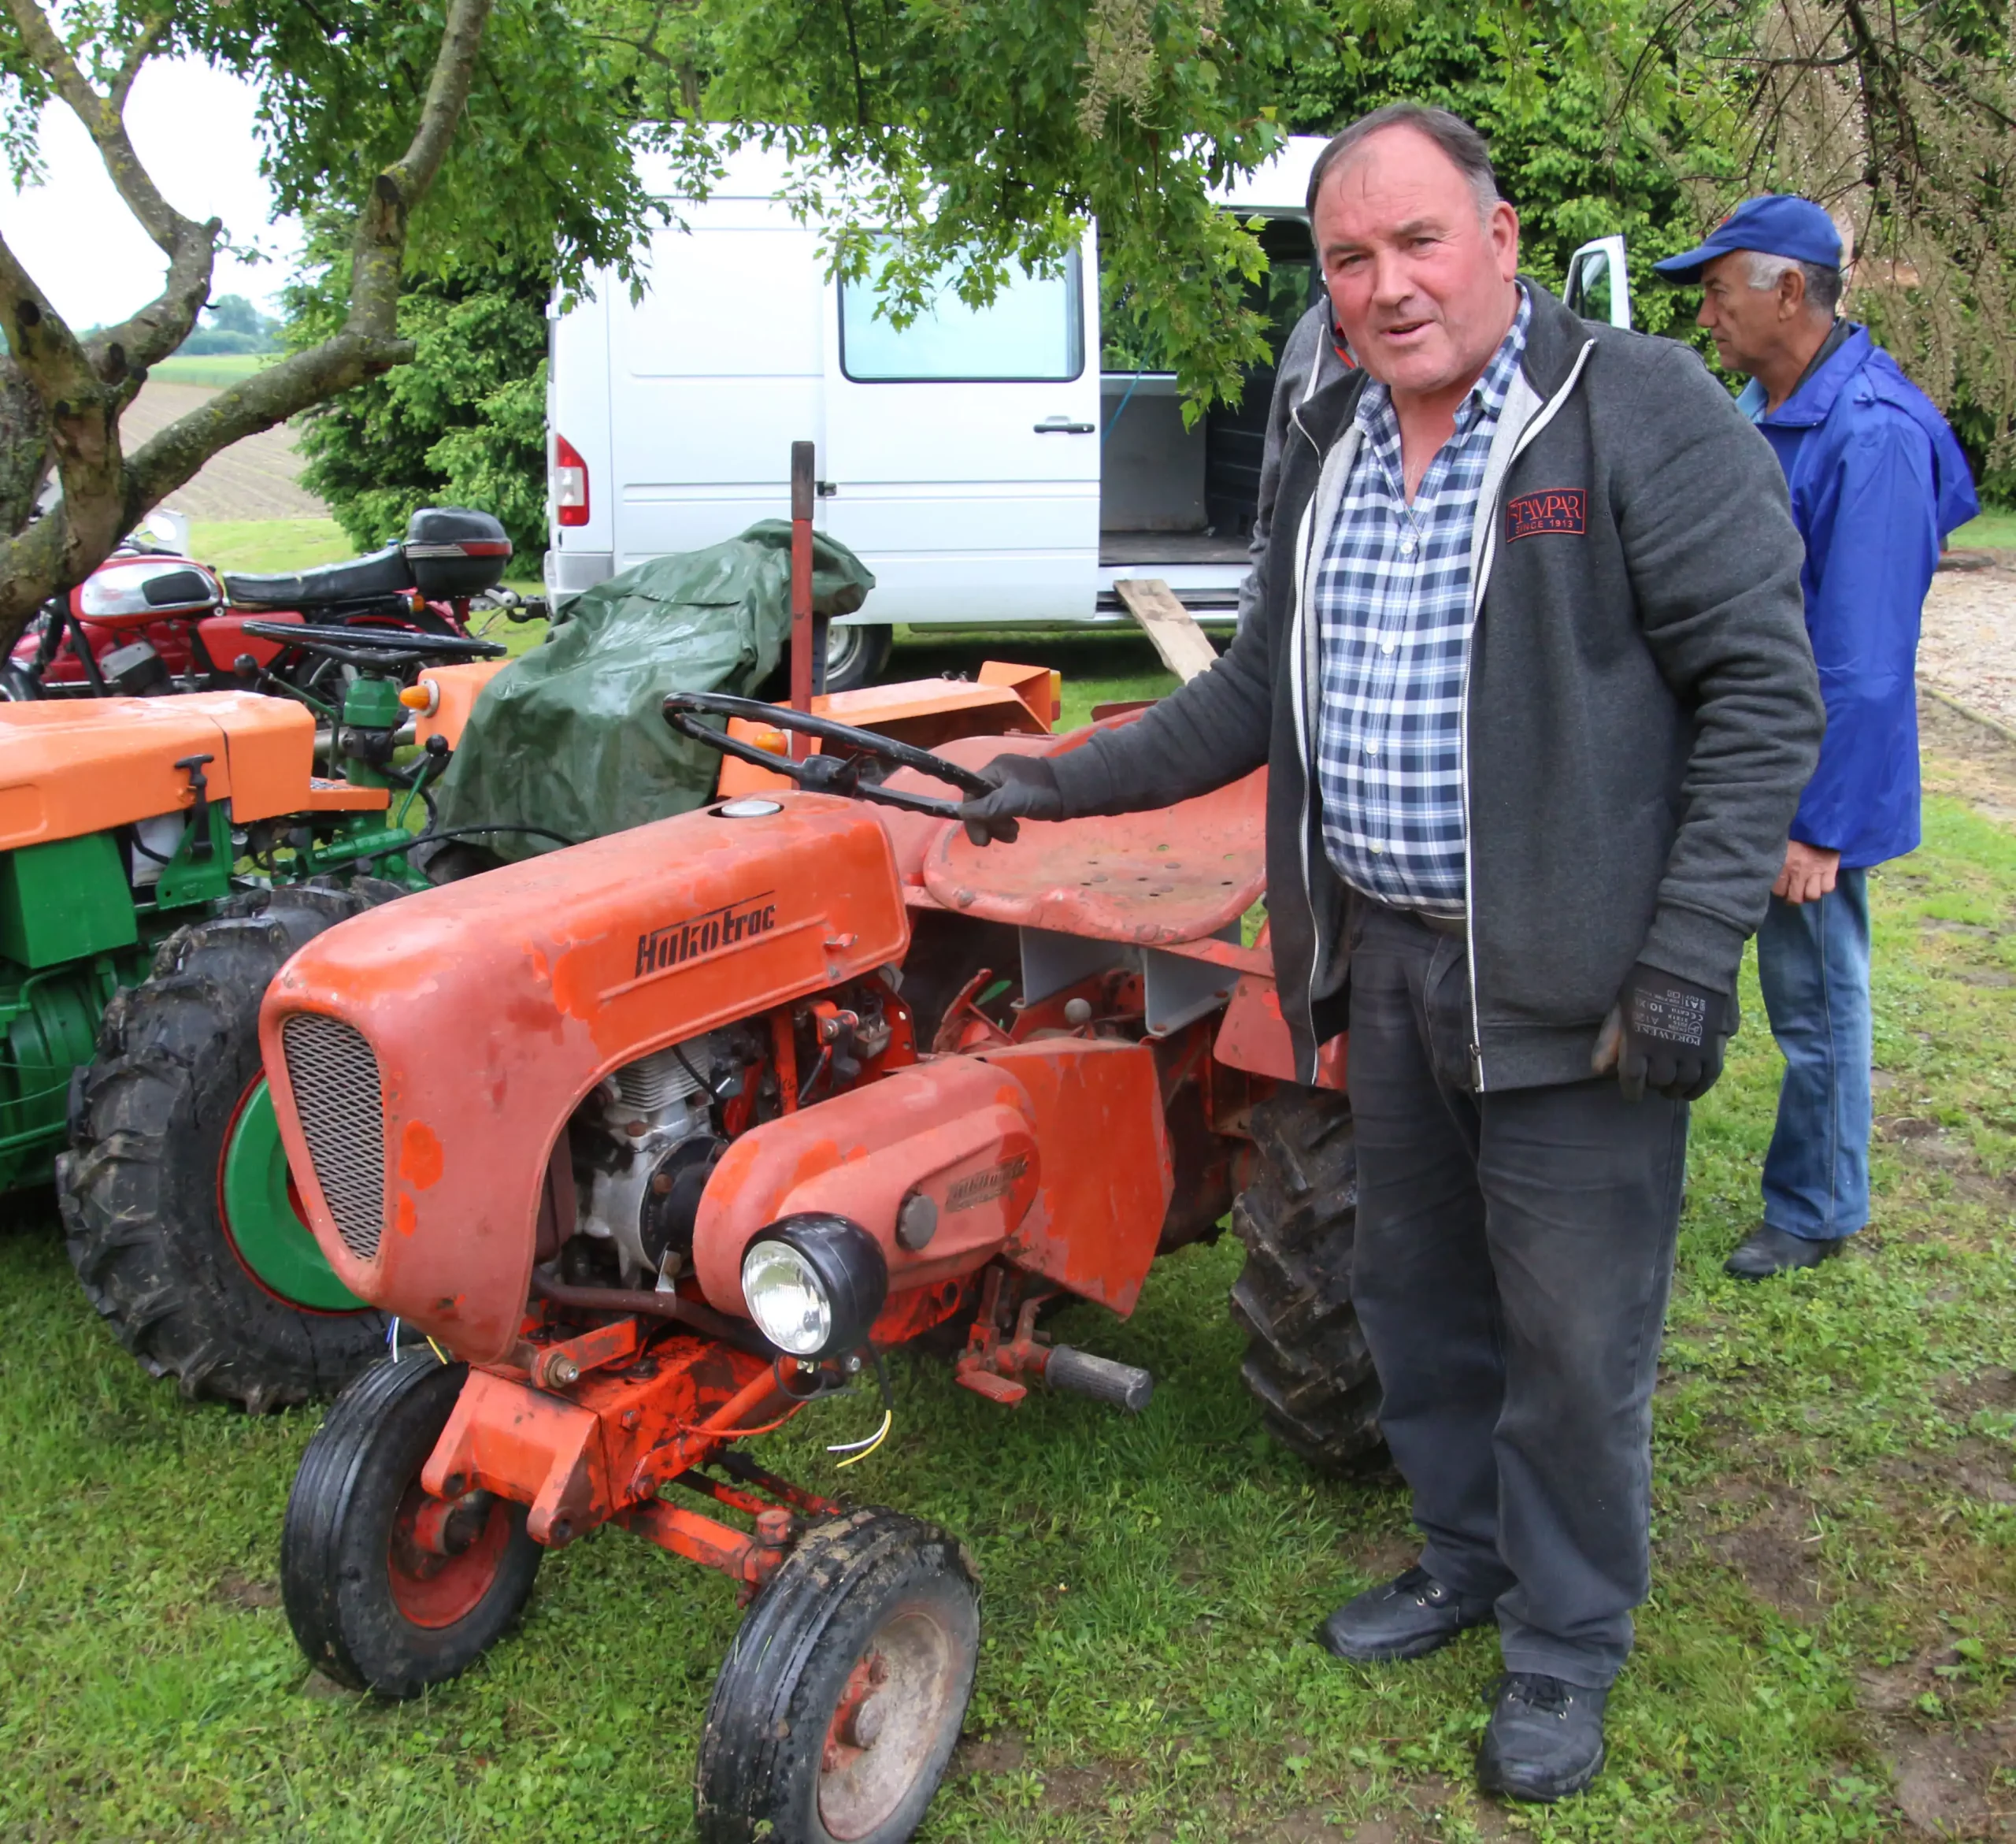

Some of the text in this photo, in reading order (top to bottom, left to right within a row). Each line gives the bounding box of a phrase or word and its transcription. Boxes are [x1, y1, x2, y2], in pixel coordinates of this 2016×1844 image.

[1515, 519, 1574, 534] SINCE 1913
[635, 904, 776, 978] Hakotrac
[1685, 1000, 1699, 1009] A1
[1634, 1026, 1700, 1046] PORTWEST
